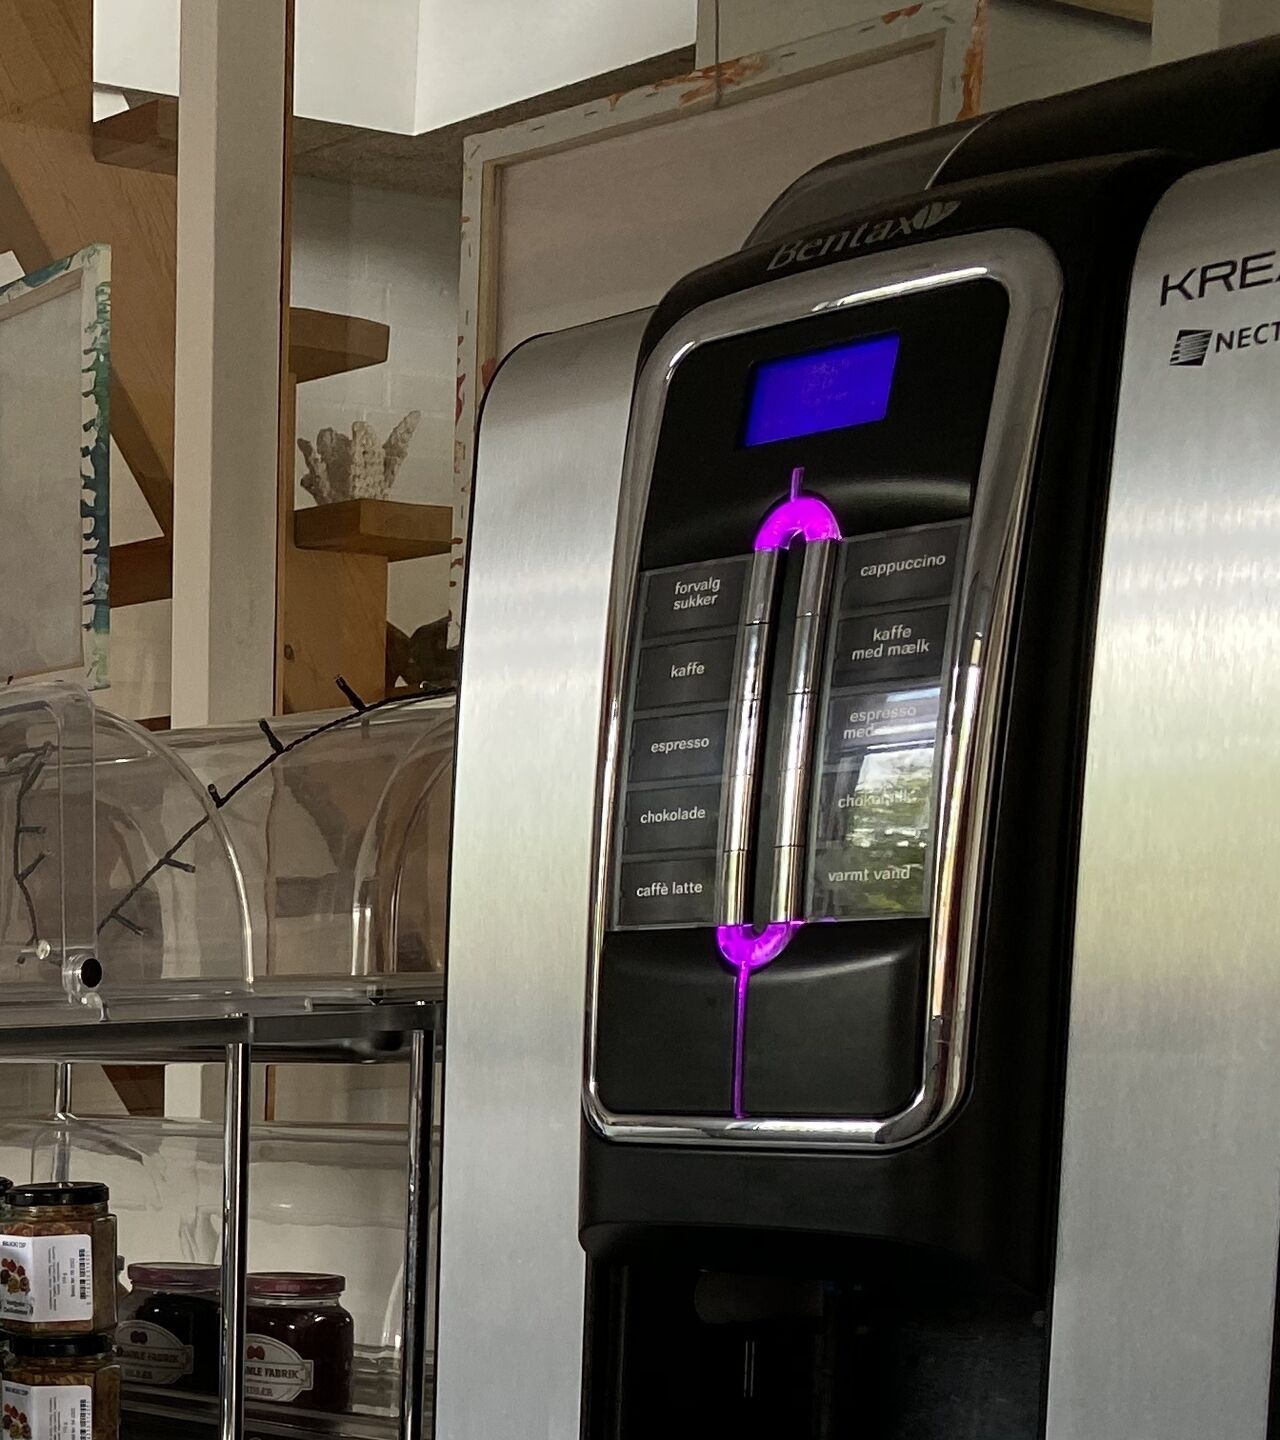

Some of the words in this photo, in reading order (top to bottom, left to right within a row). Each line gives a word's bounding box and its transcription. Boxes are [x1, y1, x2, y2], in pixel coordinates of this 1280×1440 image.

[766, 216, 913, 271] Bentax
[1160, 250, 1280, 307] KRE
[860, 554, 946, 577] cappuccino
[675, 577, 721, 595] forvalg
[673, 593, 718, 611] sukker
[873, 625, 912, 642] kaffe
[851, 643, 884, 661] med
[887, 639, 930, 657] mælk
[670, 662, 705, 678] kaffe
[850, 706, 917, 724] espresso
[843, 723, 875, 740] med
[651, 736, 710, 754] espresso
[640, 806, 706, 824] chokolade
[828, 867, 869, 882] varmt
[873, 864, 911, 880] vand
[636, 881, 668, 898] caffè
[671, 881, 703, 896] latte
[264, 1367, 300, 1380] FABRIK
